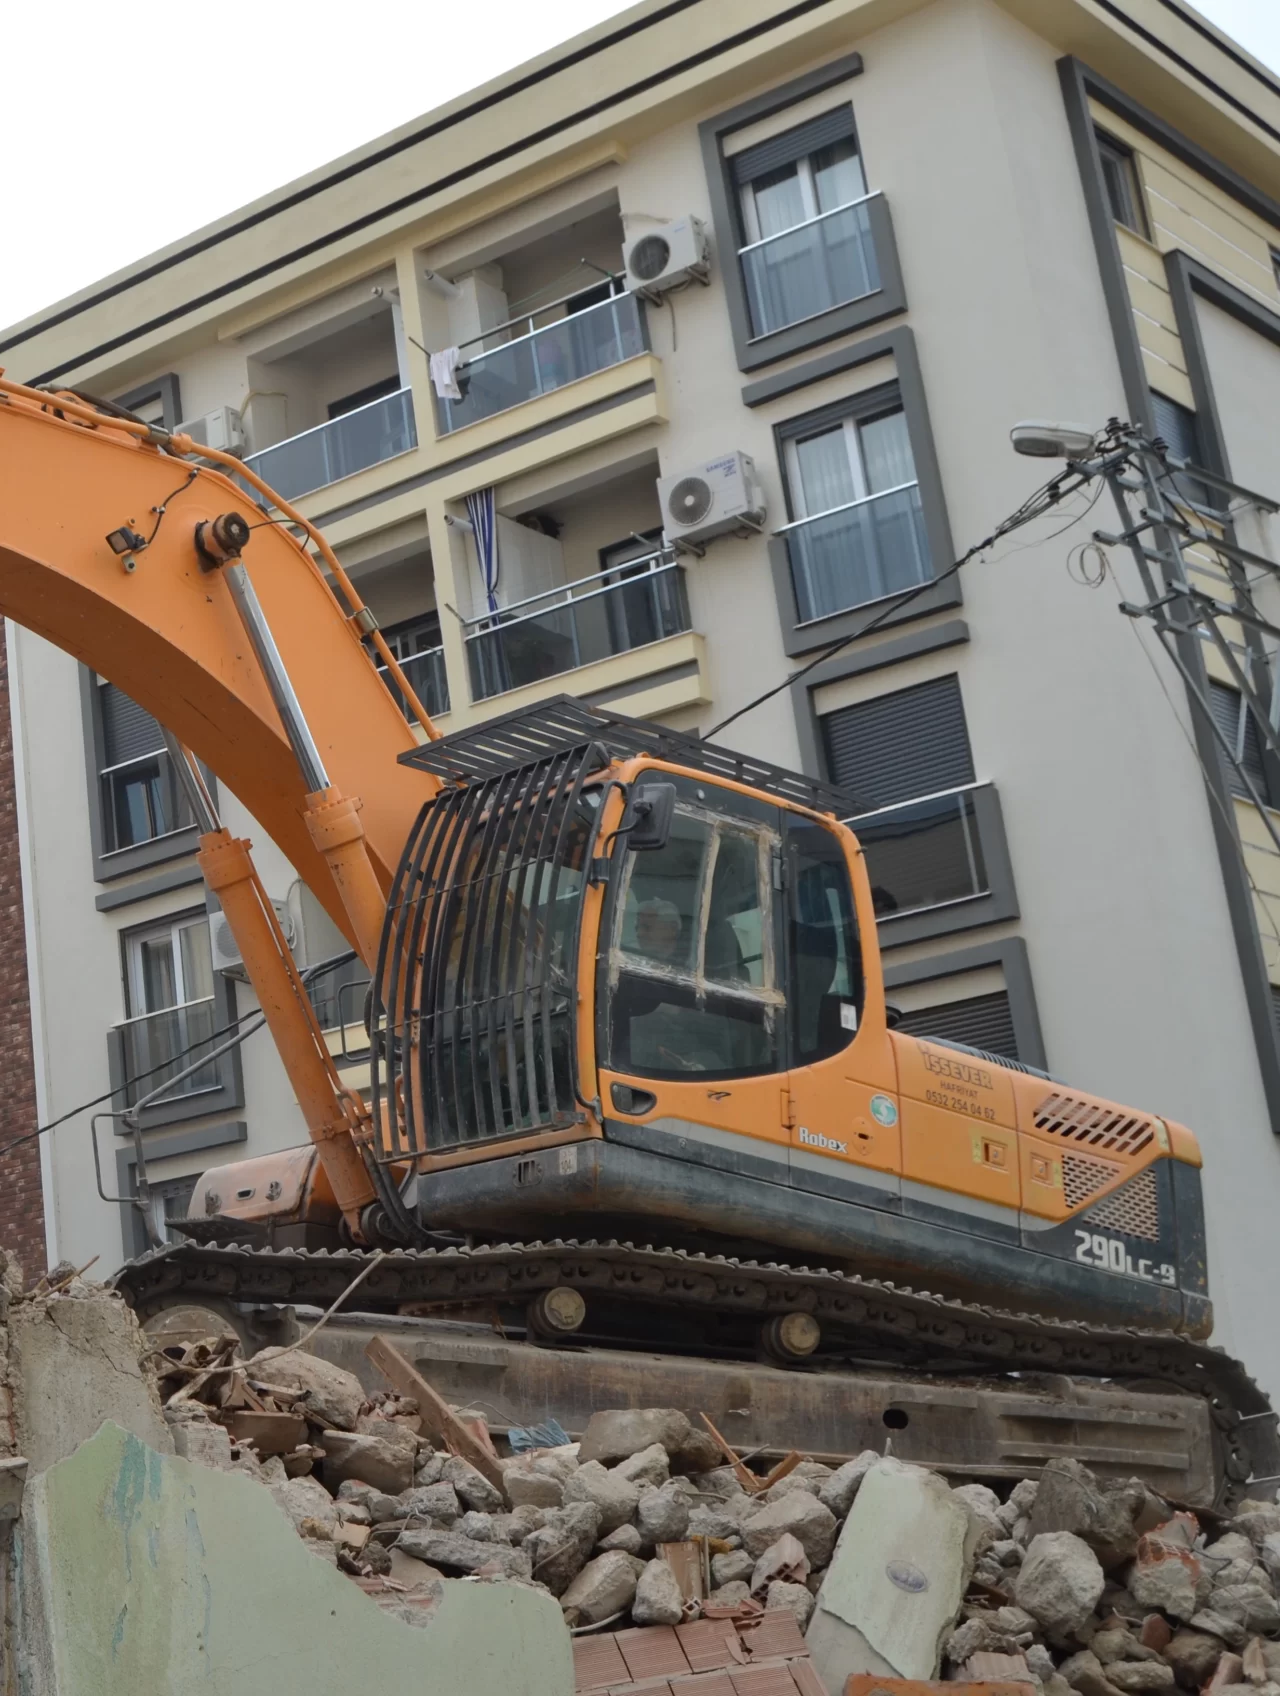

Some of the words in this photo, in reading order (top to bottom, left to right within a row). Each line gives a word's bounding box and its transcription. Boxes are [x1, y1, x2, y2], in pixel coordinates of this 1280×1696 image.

[926, 1090, 948, 1106] 0532
[951, 1097, 968, 1112] 254
[970, 1103, 982, 1115] 04
[984, 1107, 996, 1121] 62
[799, 1126, 848, 1154] Robex
